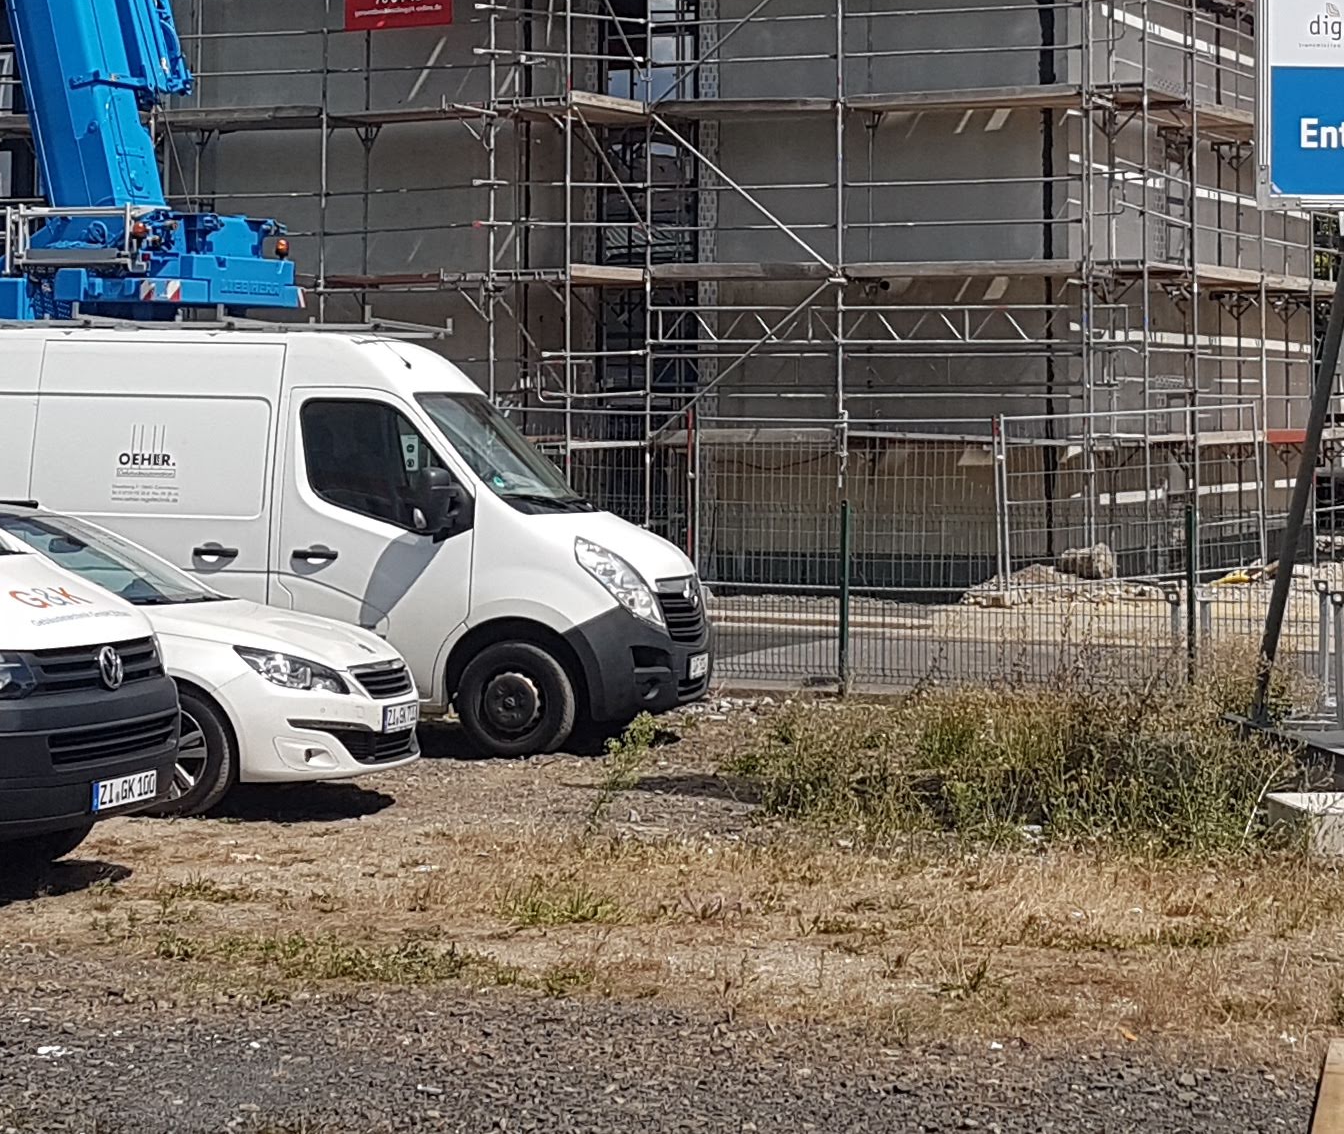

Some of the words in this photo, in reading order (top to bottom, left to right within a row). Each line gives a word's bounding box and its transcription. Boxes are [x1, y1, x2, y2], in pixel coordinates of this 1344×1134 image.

[9, 587, 94, 608] G&K
[100, 783, 113, 805] ZI
[121, 778, 135, 800] GK
[137, 774, 155, 797] 100
